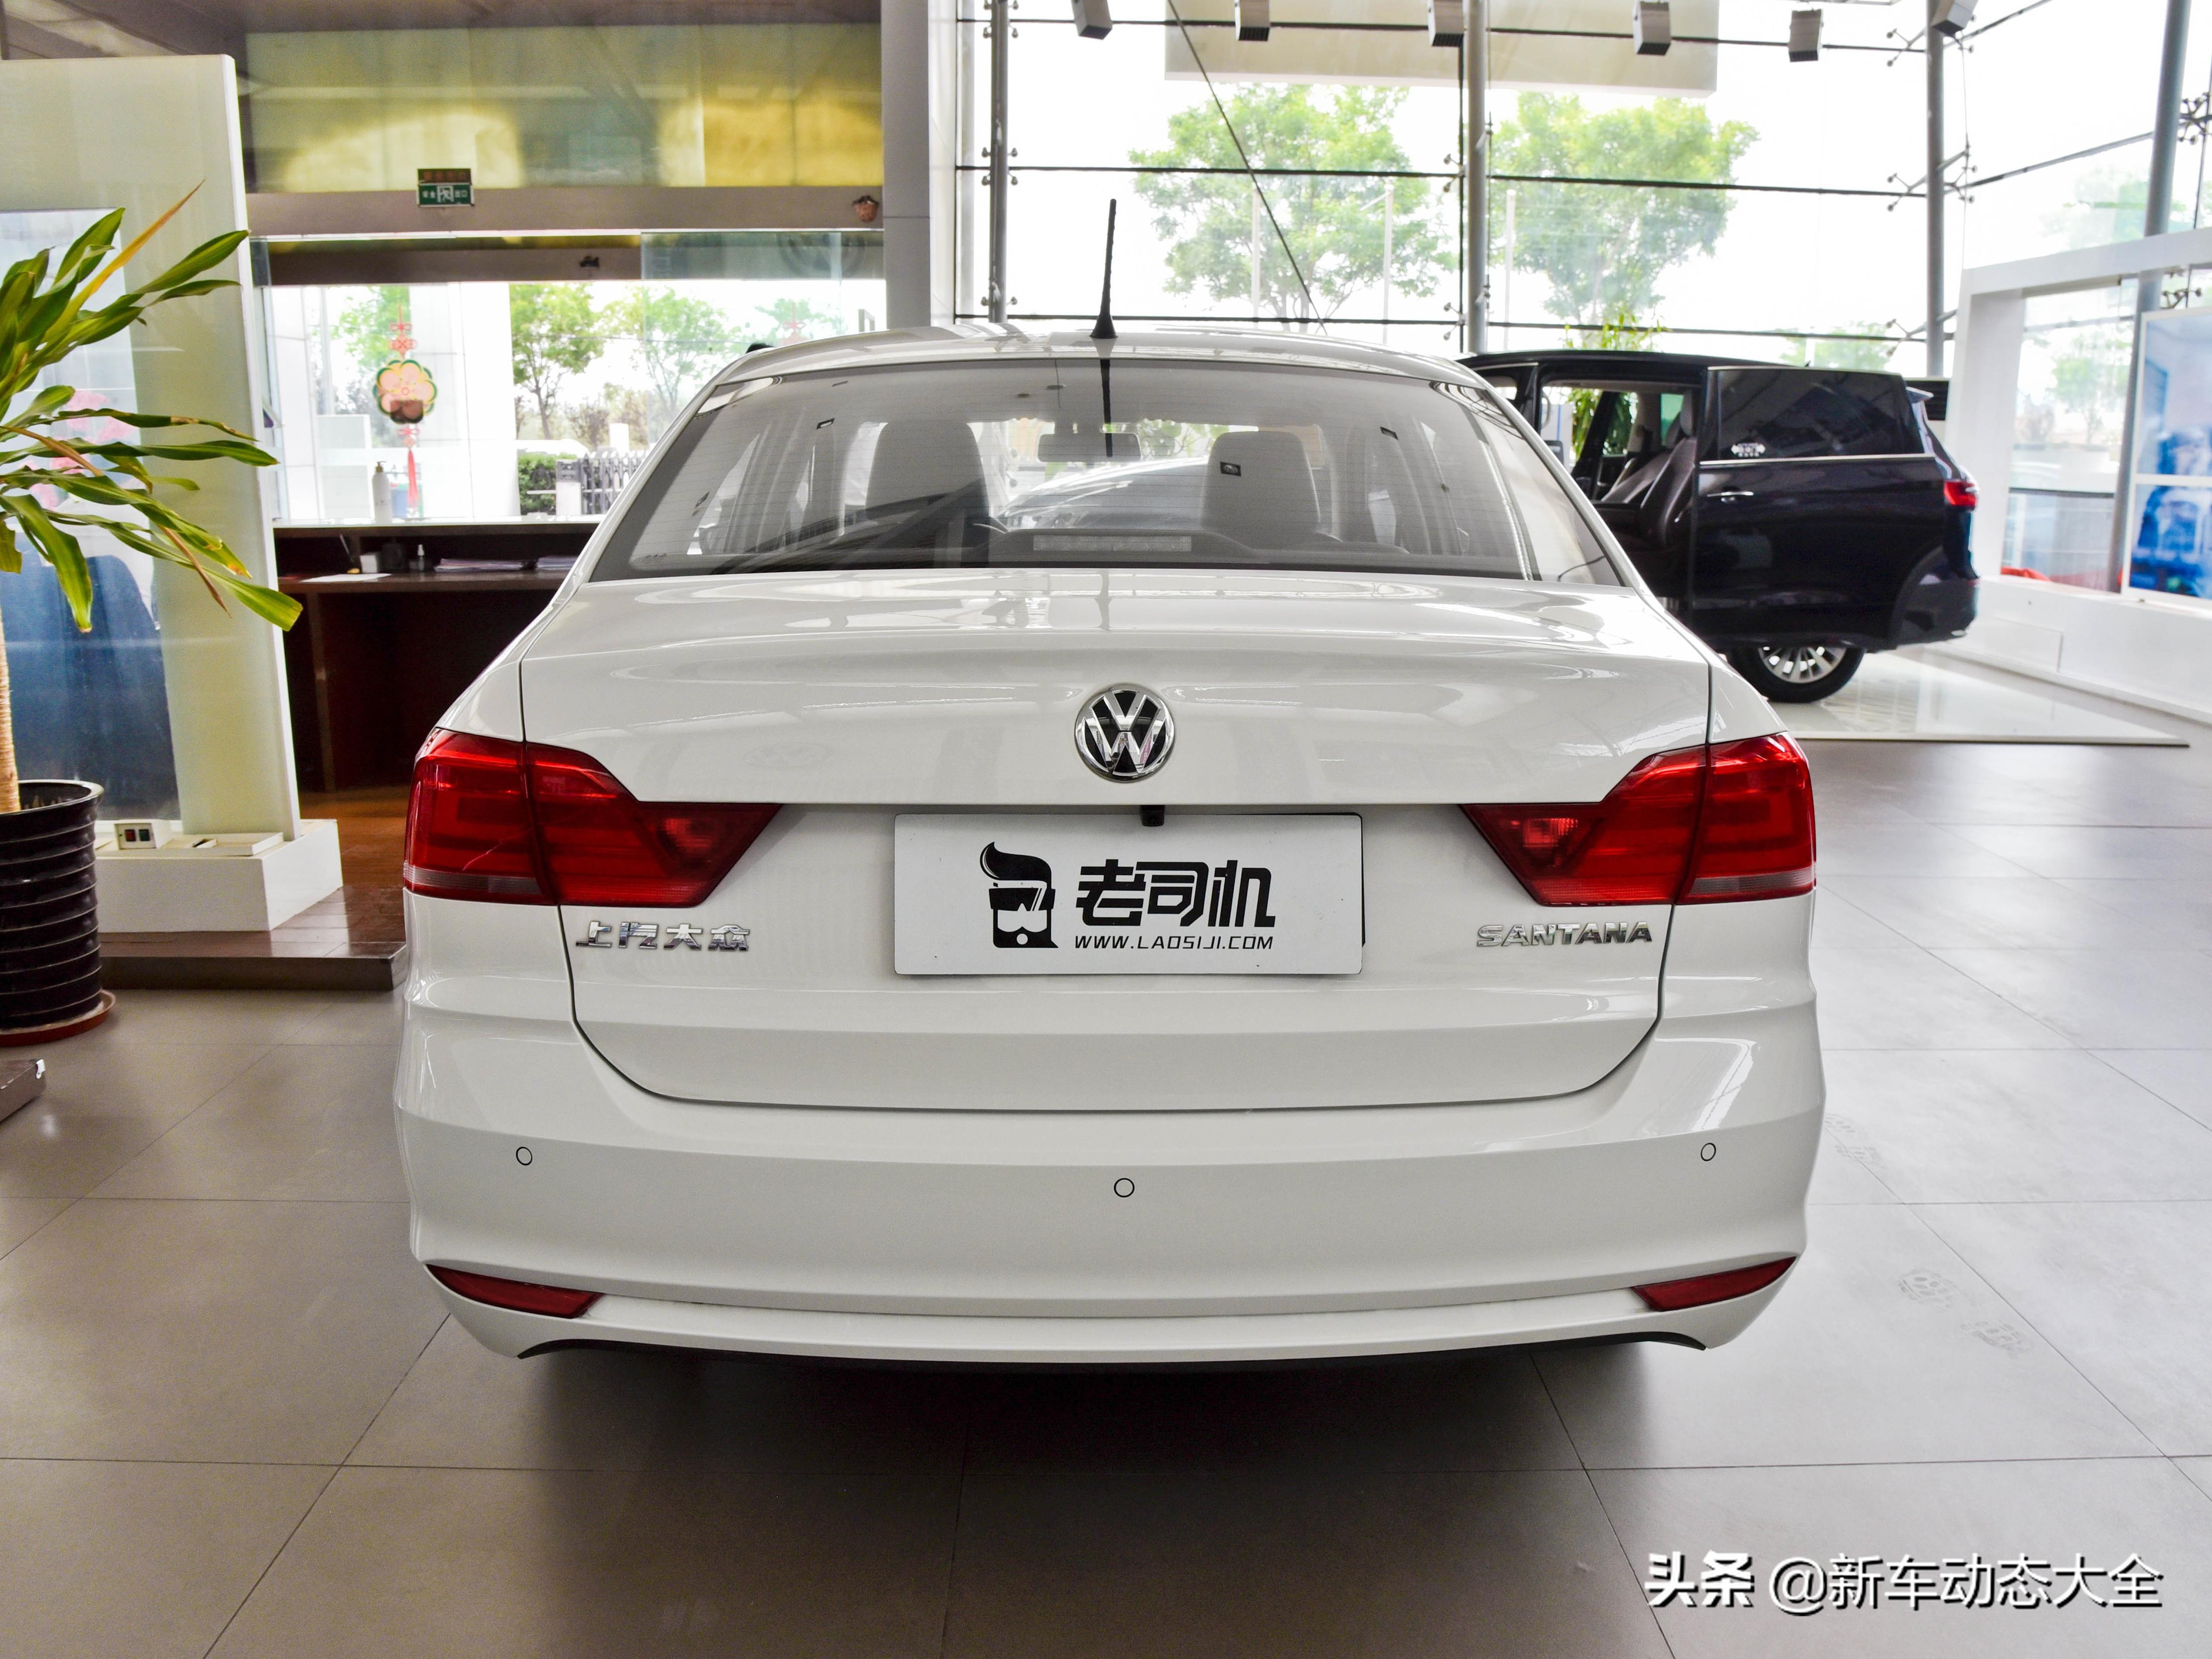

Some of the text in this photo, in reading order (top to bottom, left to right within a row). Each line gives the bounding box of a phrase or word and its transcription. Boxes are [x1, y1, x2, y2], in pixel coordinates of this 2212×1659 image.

[1076, 859, 1276, 927] 老司机
[576, 920, 751, 951] 上汽大众
[1075, 936, 1273, 950] WWW.LAOSIJI.COM
[1477, 921, 1653, 947] SANTANA
